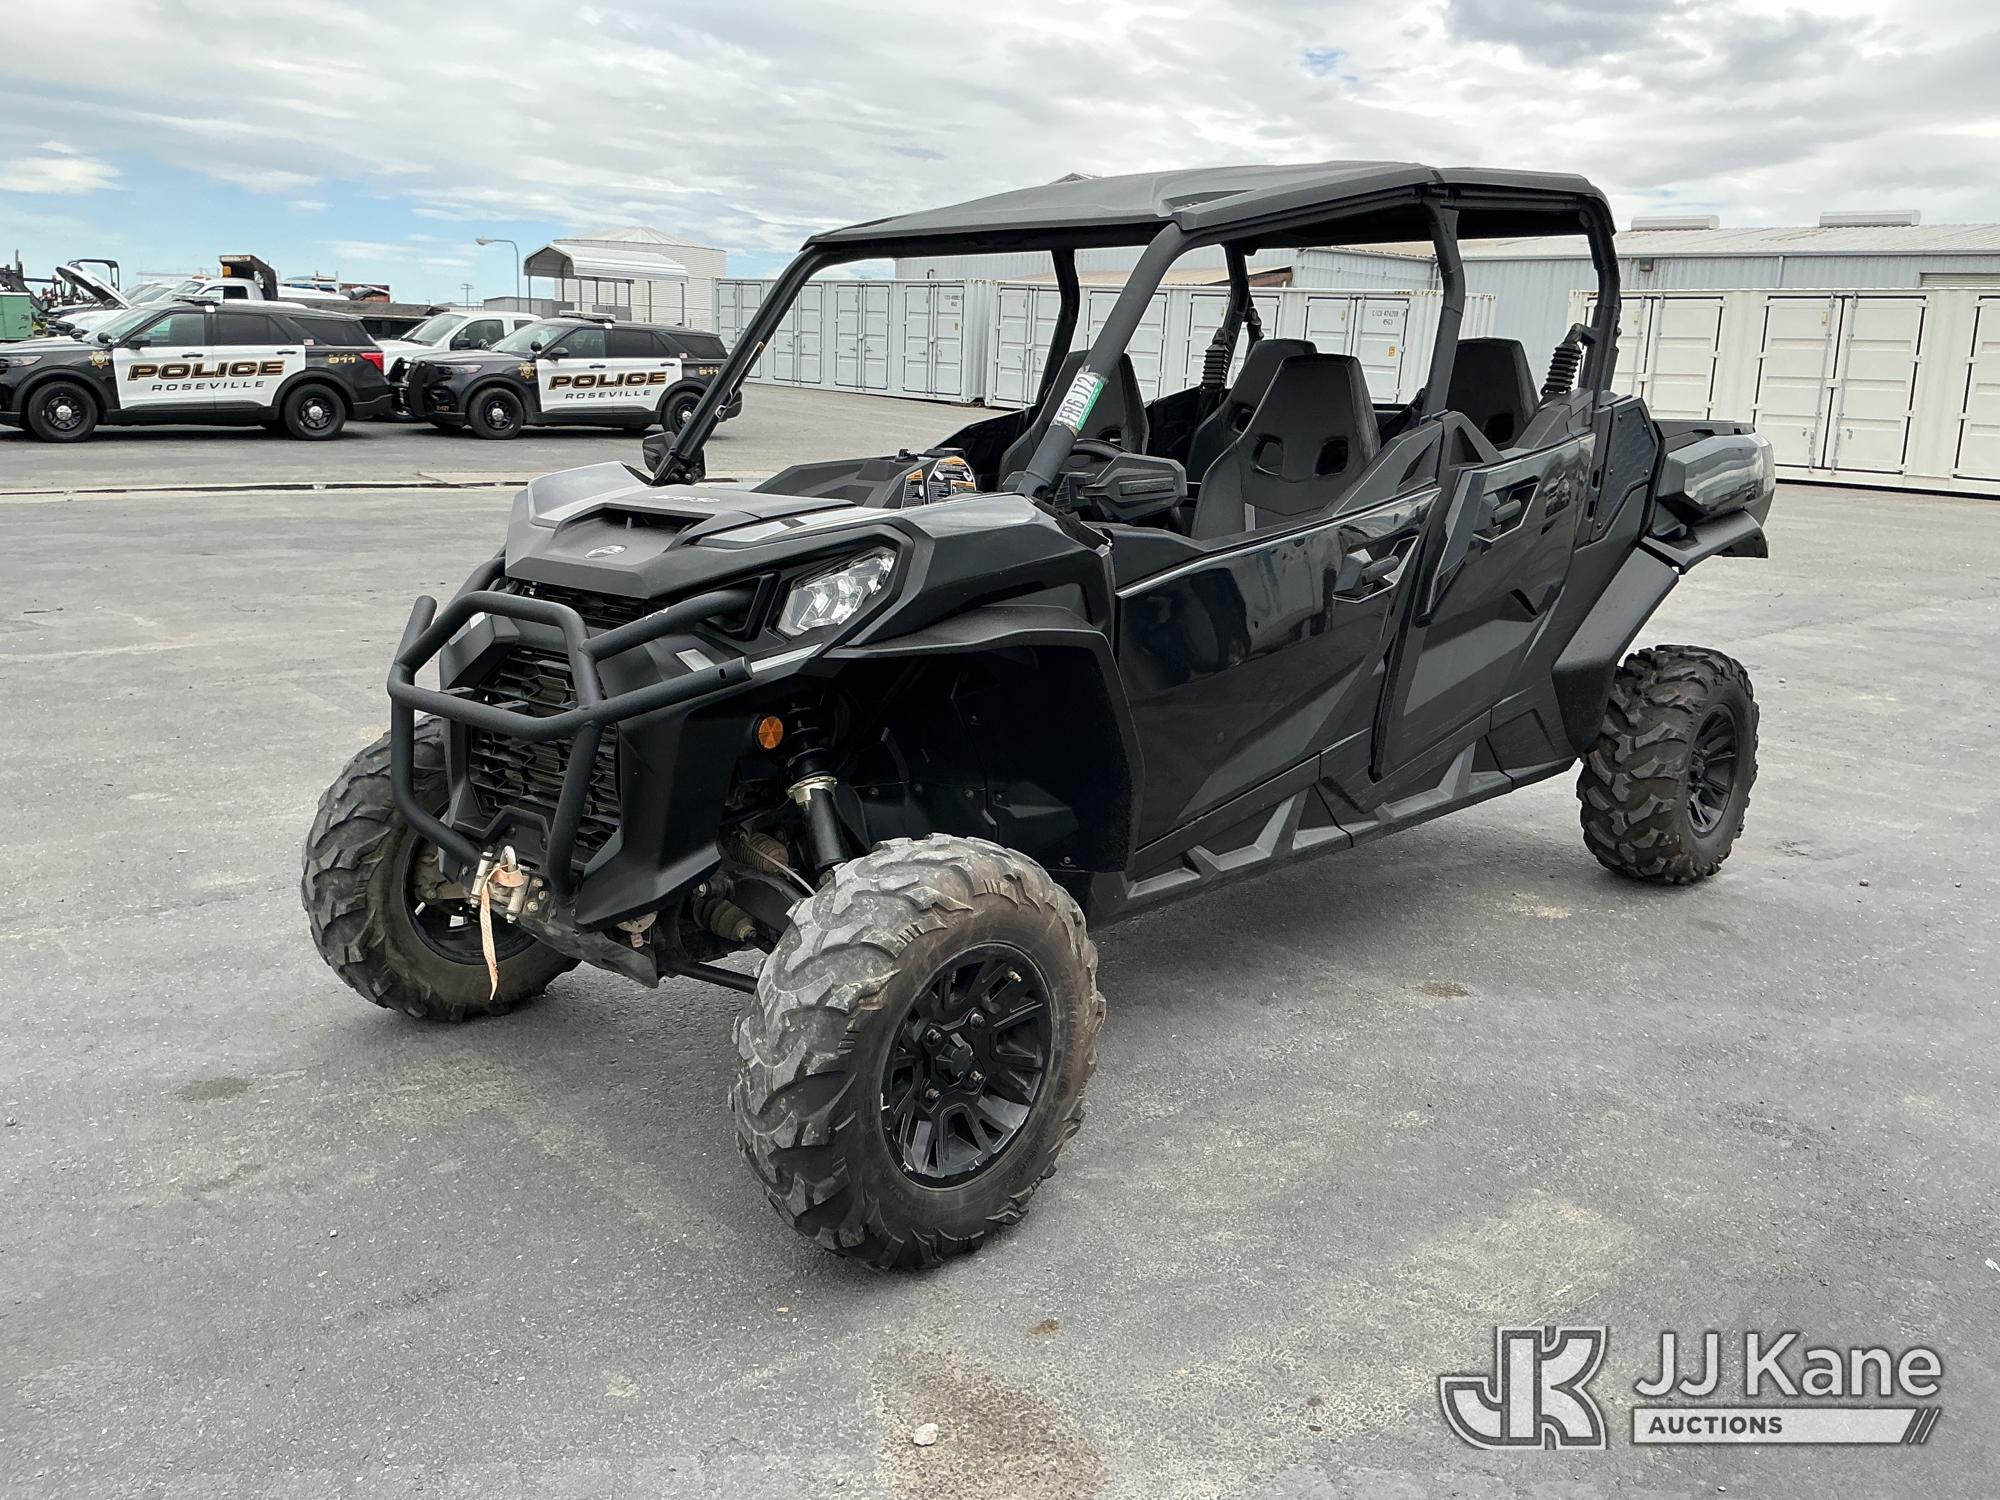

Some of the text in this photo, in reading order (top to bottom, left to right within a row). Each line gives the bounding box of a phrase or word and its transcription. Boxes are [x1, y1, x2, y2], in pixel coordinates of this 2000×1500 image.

[128, 360, 285, 381] POLICE
[151, 381, 265, 392] ROSEVILLE
[548, 372, 667, 390] POLICE
[565, 389, 651, 400] ROSEVILLE
